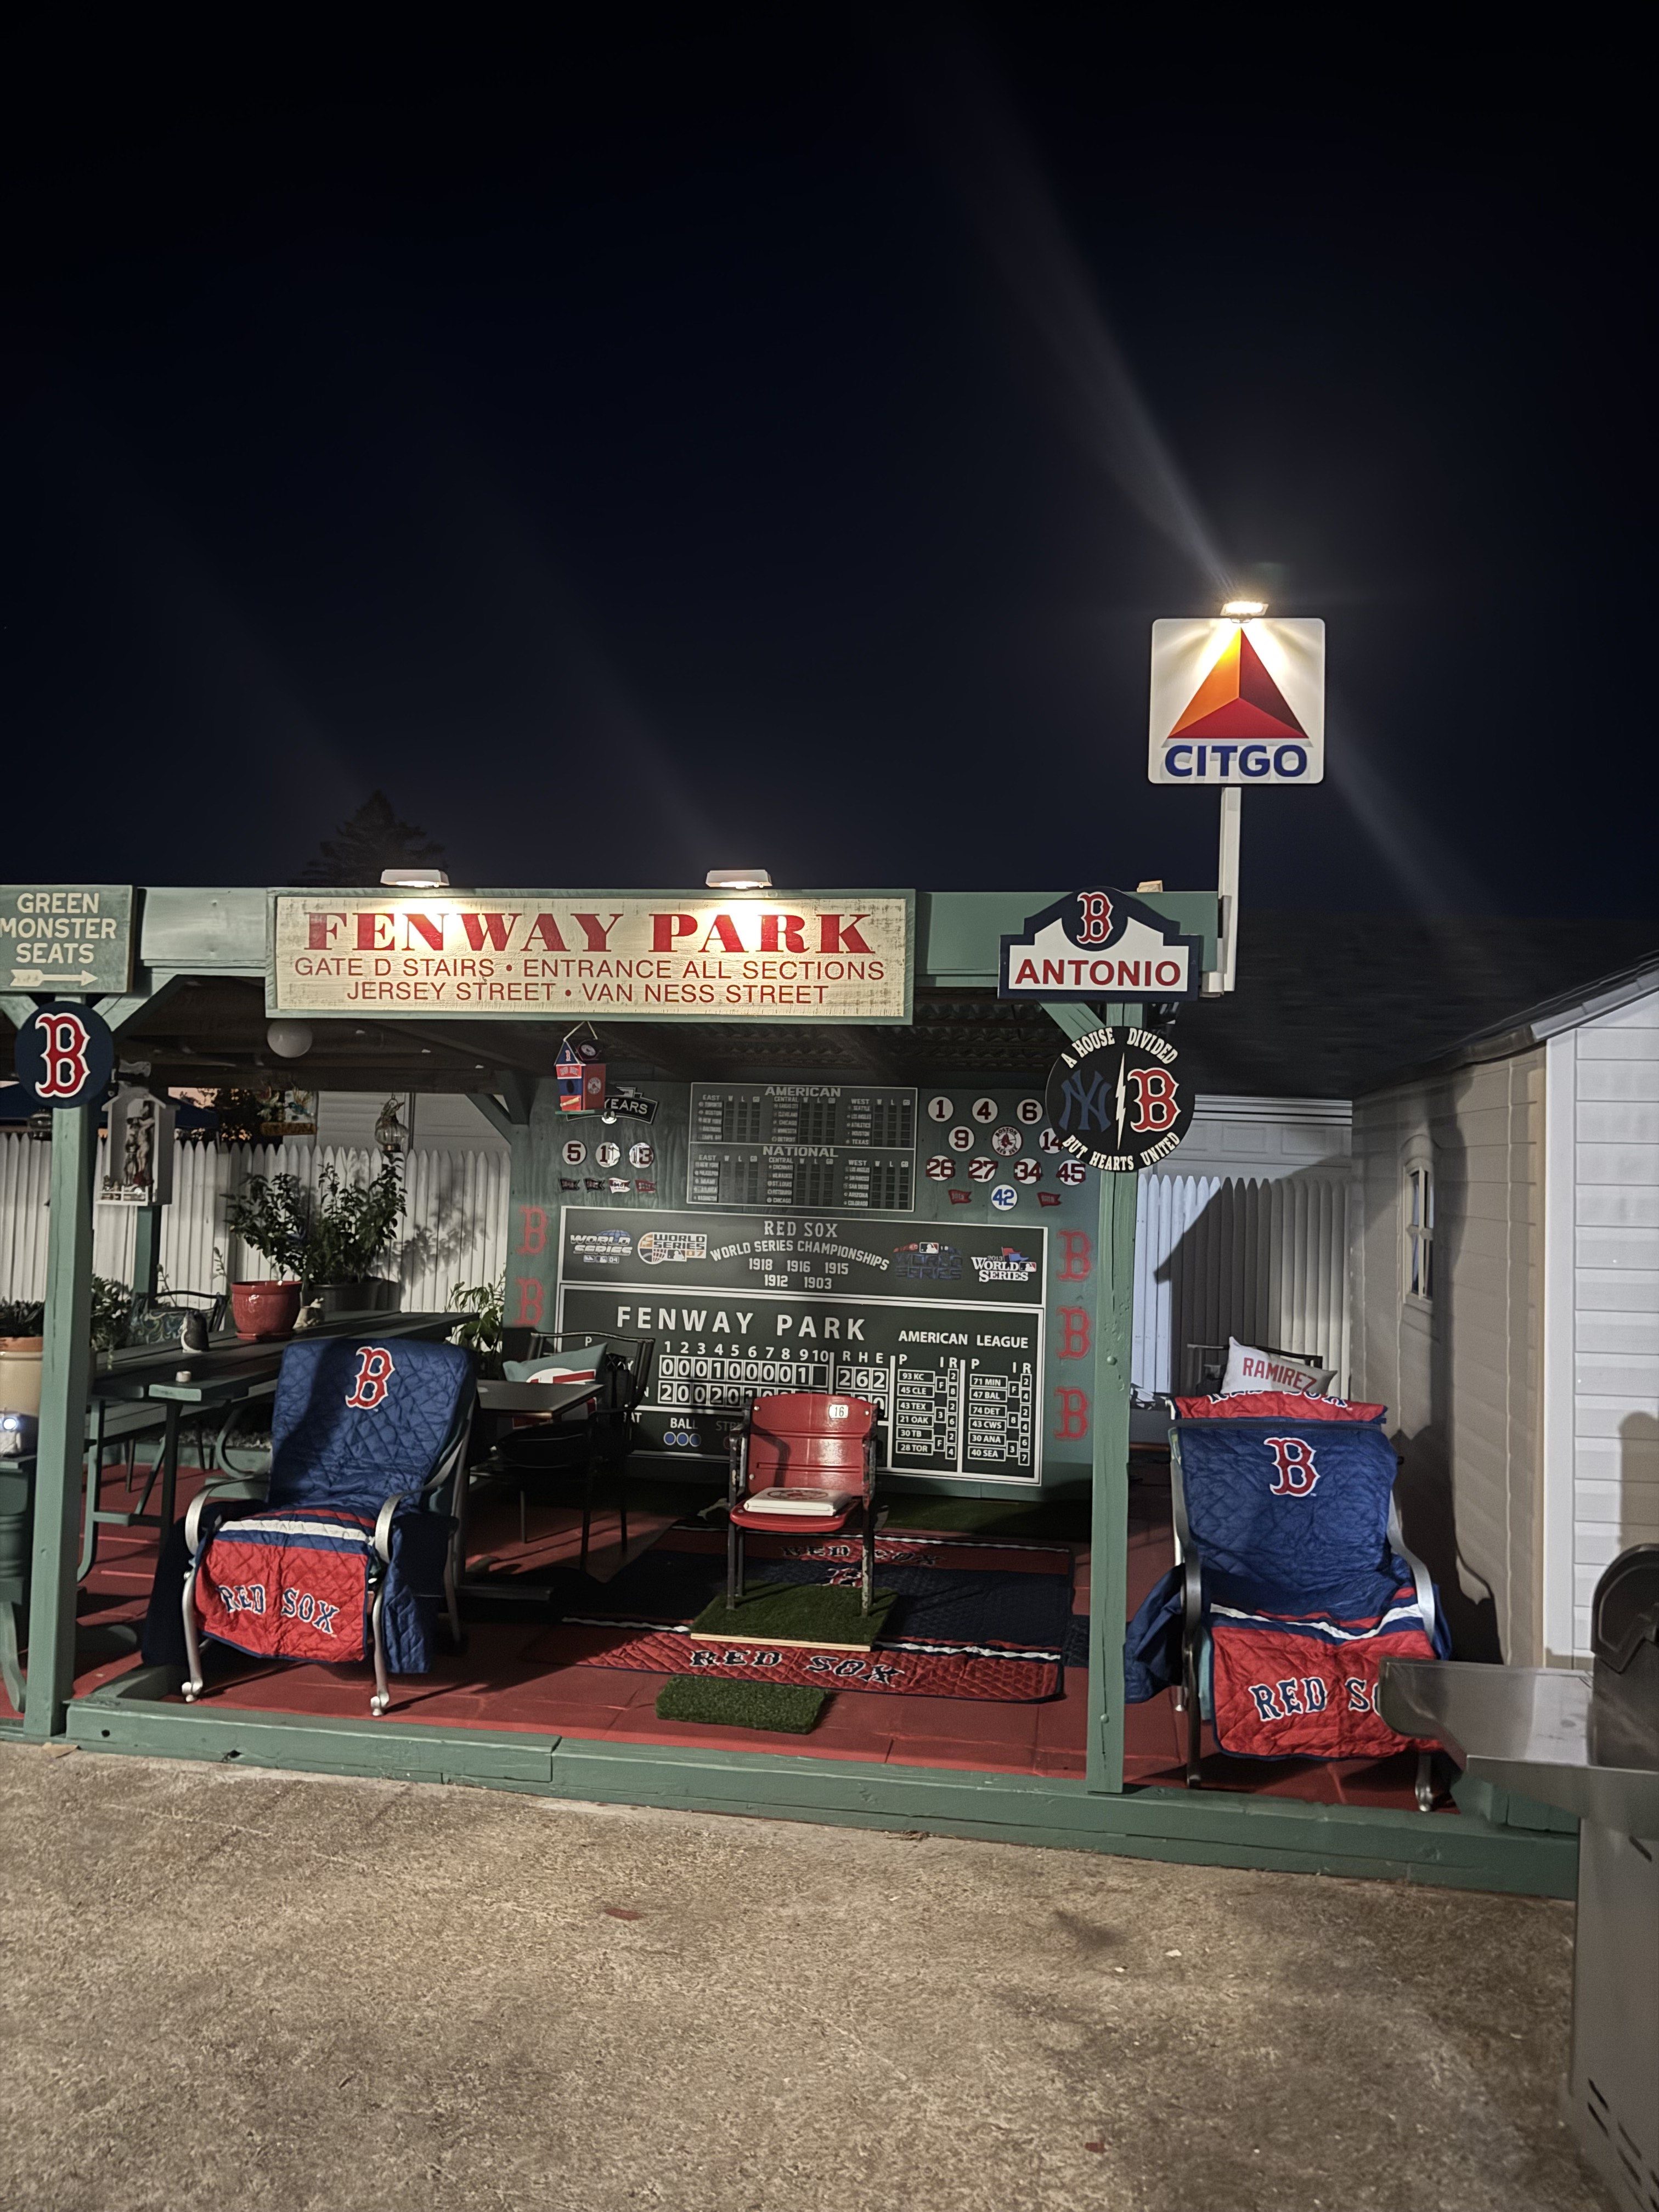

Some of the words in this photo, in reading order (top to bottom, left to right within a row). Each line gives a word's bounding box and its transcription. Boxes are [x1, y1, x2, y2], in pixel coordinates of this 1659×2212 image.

[1165, 745, 1307, 777] CITGO
[16, 893, 98, 913] GREEN
[1076, 891, 1114, 944] B
[0, 918, 116, 939] MONSTER
[304, 912, 623, 952] FENWAY
[648, 913, 875, 953] PARK
[16, 943, 94, 963] SEATS
[295, 957, 363, 975] GATE
[375, 958, 391, 975] D
[403, 958, 494, 977] STAIRS
[524, 960, 672, 978] ENTRANCE
[684, 961, 731, 978] ALL
[742, 961, 884, 980] SECTIONS
[1015, 959, 1181, 986] ANTONIO
[347, 981, 446, 1001] JERSEY
[456, 983, 556, 1001] STREET
[582, 983, 632, 1002] VAN
[645, 984, 714, 1003] NESS
[726, 985, 829, 1003] STREET
[35, 1012, 91, 1098] B
[1062, 1053, 1077, 1068] A
[1072, 1028, 1115, 1058] HOUSE
[1127, 1028, 1178, 1064] DIVIDED
[765, 1087, 840, 1097] AMERICAN
[1059, 1070, 1112, 1132] NY
[1128, 1068, 1181, 1132] B
[936, 1100, 945, 1119] 1
[977, 1101, 991, 1120] 4
[1022, 1102, 1037, 1121] 6
[955, 1130, 969, 1148] 9
[995, 1127, 1018, 1136] BOSTON
[1042, 1131, 1063, 1150] 14
[567, 1144, 582, 1161] 5
[763, 1146, 838, 1157] NATIONAL
[1062, 1135, 1088, 1159] BUT
[1090, 1152, 1133, 1171] HEARTS
[1141, 1132, 1181, 1165] UNITED
[926, 1159, 955, 1178] 26
[968, 1160, 998, 1179] 27
[1014, 1161, 1043, 1181] 34
[1056, 1163, 1086, 1183] 45
[992, 1189, 1014, 1206] 42
[516, 1205, 549, 1256] B
[764, 1221, 796, 1236] RED
[804, 1222, 838, 1237] SOX
[571, 1235, 630, 1246] WORLD
[573, 1245, 633, 1255] SERIES
[654, 1242, 705, 1250] SERIES
[710, 1242, 751, 1262] WORLD
[754, 1240, 793, 1252] SERIES
[797, 1240, 890, 1271] CHAMPIONSHIPS
[971, 1257, 1019, 1271] WORLD
[1056, 1227, 1093, 1282] B
[749, 1258, 772, 1271] 1918
[787, 1260, 810, 1272] 1916
[825, 1262, 848, 1274] 1915
[764, 1274, 788, 1286] 1912
[804, 1277, 832, 1289] 1903
[979, 1271, 1028, 1282] SERIES
[513, 1276, 545, 1326] B
[617, 1306, 753, 1334] FENWAY
[777, 1315, 866, 1341] PARK
[1054, 1305, 1092, 1360] B
[898, 1330, 968, 1345] AMERICAN
[977, 1335, 1028, 1348] LEAGUE
[665, 1341, 670, 1353] 1
[680, 1342, 689, 1353] 2
[697, 1343, 706, 1354] 3
[714, 1344, 723, 1355] 4
[731, 1345, 739, 1356] 5
[748, 1346, 757, 1358] 6
[766, 1347, 774, 1358] 7
[781, 1348, 790, 1359] 8
[799, 1348, 809, 1361] 9
[812, 1350, 828, 1362] 10
[843, 1351, 850, 1361] R
[859, 1352, 868, 1363] H
[876, 1353, 883, 1363] E
[899, 1354, 907, 1364] P
[940, 1356, 944, 1368] I
[949, 1357, 957, 1368] R
[662, 1359, 673, 1375] 0
[679, 1359, 690, 1376] 0
[696, 1361, 707, 1377] 0
[714, 1362, 720, 1378] 1
[730, 1363, 741, 1379] 0
[746, 1364, 758, 1380] 0
[763, 1365, 775, 1381] 0
[780, 1366, 791, 1383] 0
[798, 1367, 805, 1383] 1
[839, 1370, 850, 1386] 2
[857, 1372, 868, 1387] 6
[874, 1372, 884, 1388] 2
[971, 1359, 979, 1369] P
[1013, 1362, 1016, 1373] I
[1023, 1363, 1031, 1373] R
[1243, 1357, 1317, 1393] RAMIREZ
[345, 1345, 396, 1410] B
[985, 1378, 1001, 1386] MIN
[661, 1385, 672, 1400] 2
[678, 1385, 689, 1402] 0
[695, 1386, 706, 1402] 0
[711, 1387, 722, 1403] 2
[727, 1389, 738, 1404] 0
[835, 1407, 844, 1417] 16
[1053, 1386, 1089, 1442] B
[670, 1418, 698, 1429] BALL
[983, 1435, 1001, 1443] ANA
[1264, 1437, 1320, 1497] B
[216, 1584, 266, 1614] RED
[280, 1587, 341, 1634] SOX
[690, 1649, 783, 1668] RED
[804, 1655, 905, 1686] SOX
[1248, 1677, 1328, 1722] RED
